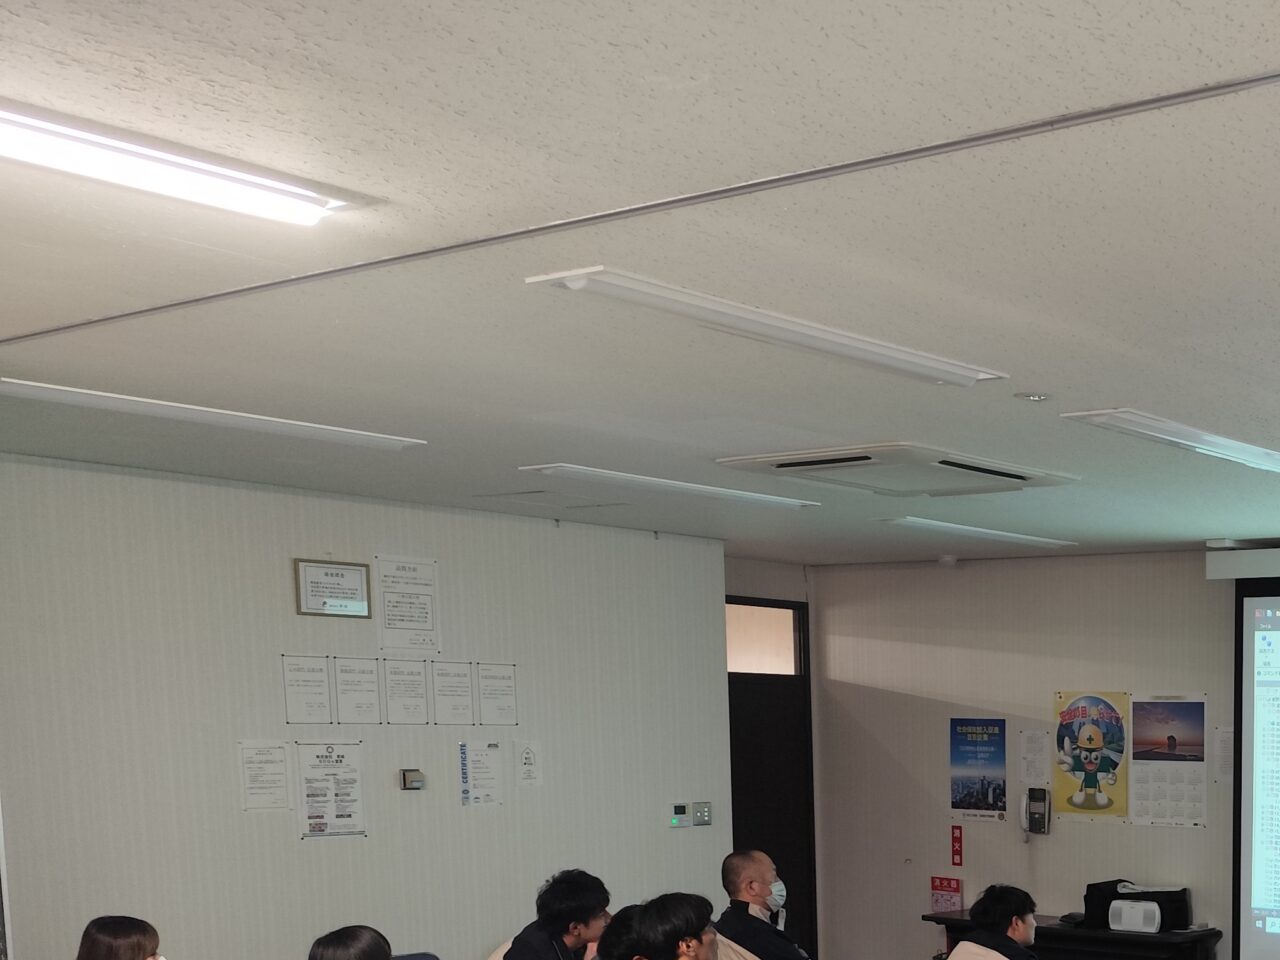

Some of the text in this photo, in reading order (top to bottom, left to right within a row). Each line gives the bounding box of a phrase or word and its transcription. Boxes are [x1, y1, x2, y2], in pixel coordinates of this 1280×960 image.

[460, 744, 469, 784] CERTIFICATE
[933, 878, 957, 889] 消火器
